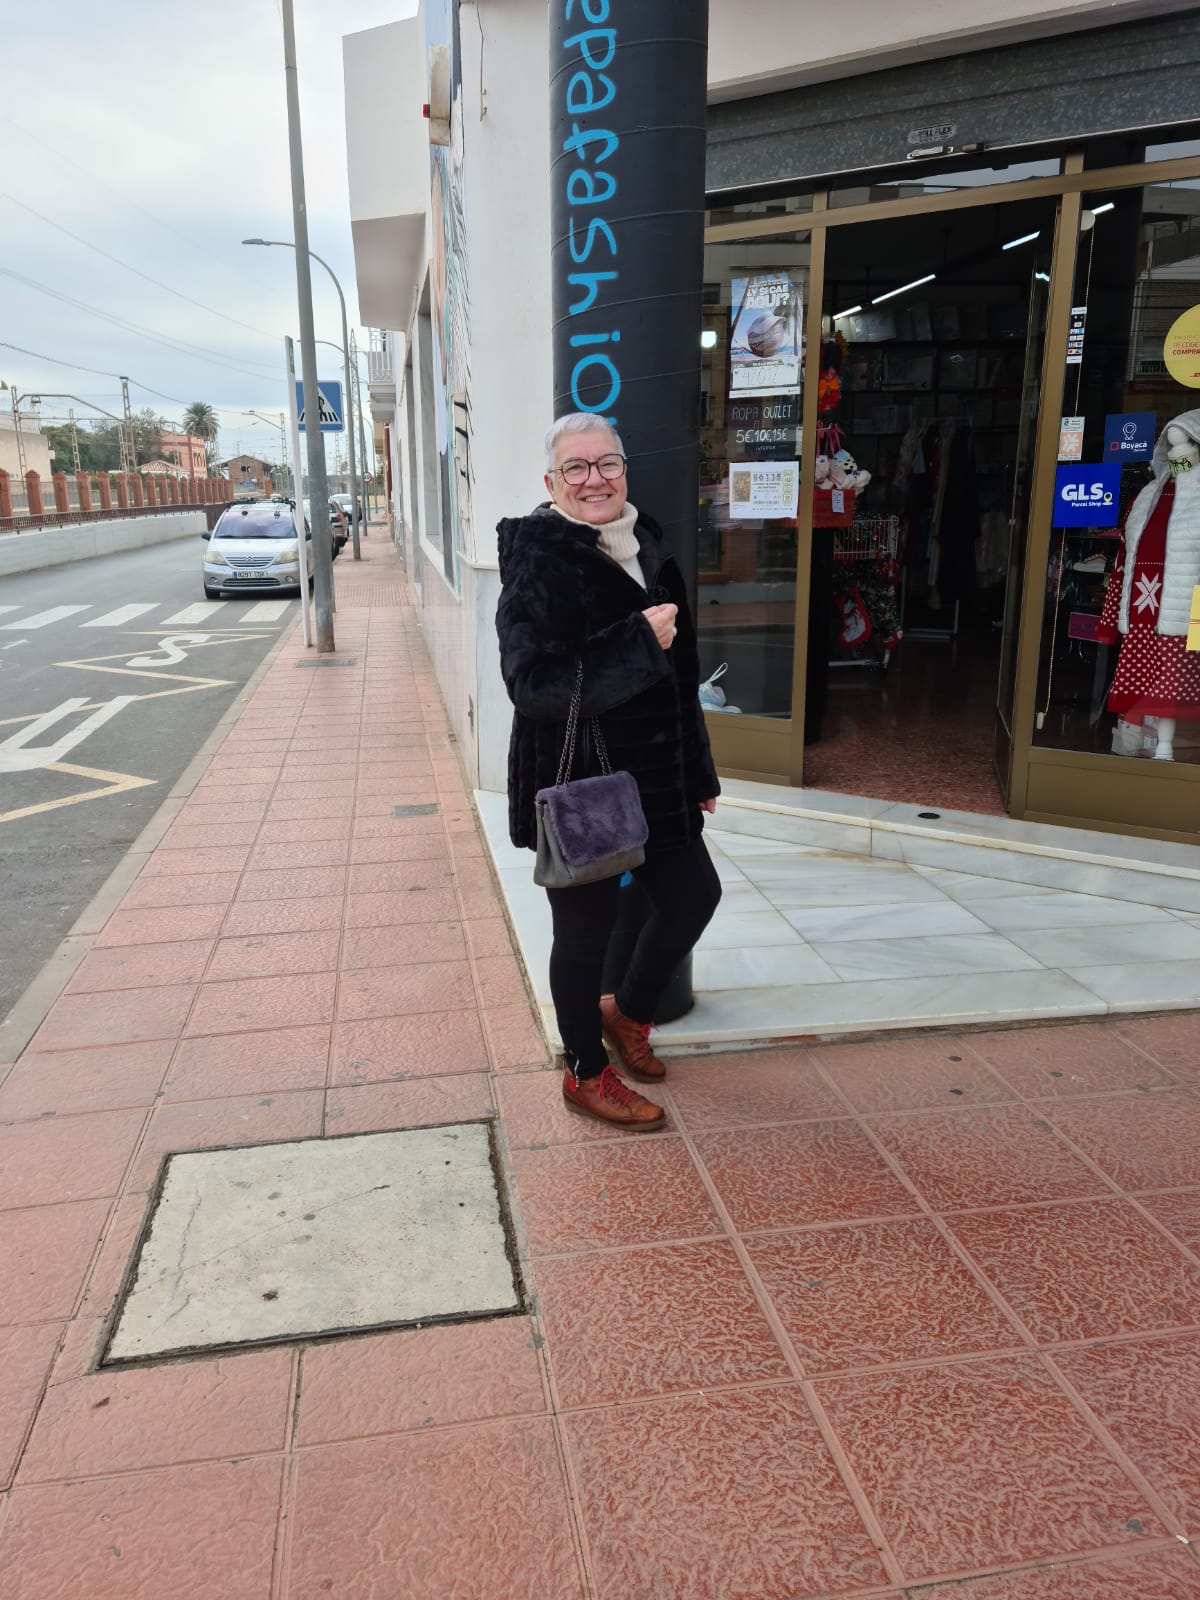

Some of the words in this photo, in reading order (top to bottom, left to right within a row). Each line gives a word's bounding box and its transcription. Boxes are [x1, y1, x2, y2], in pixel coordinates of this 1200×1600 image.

[769, 284, 789, 294] CAE
[733, 407, 759, 420] ROPA
[763, 405, 792, 419] OUTLET
[1061, 482, 1104, 501] GLS
[1088, 500, 1102, 508] Shop
